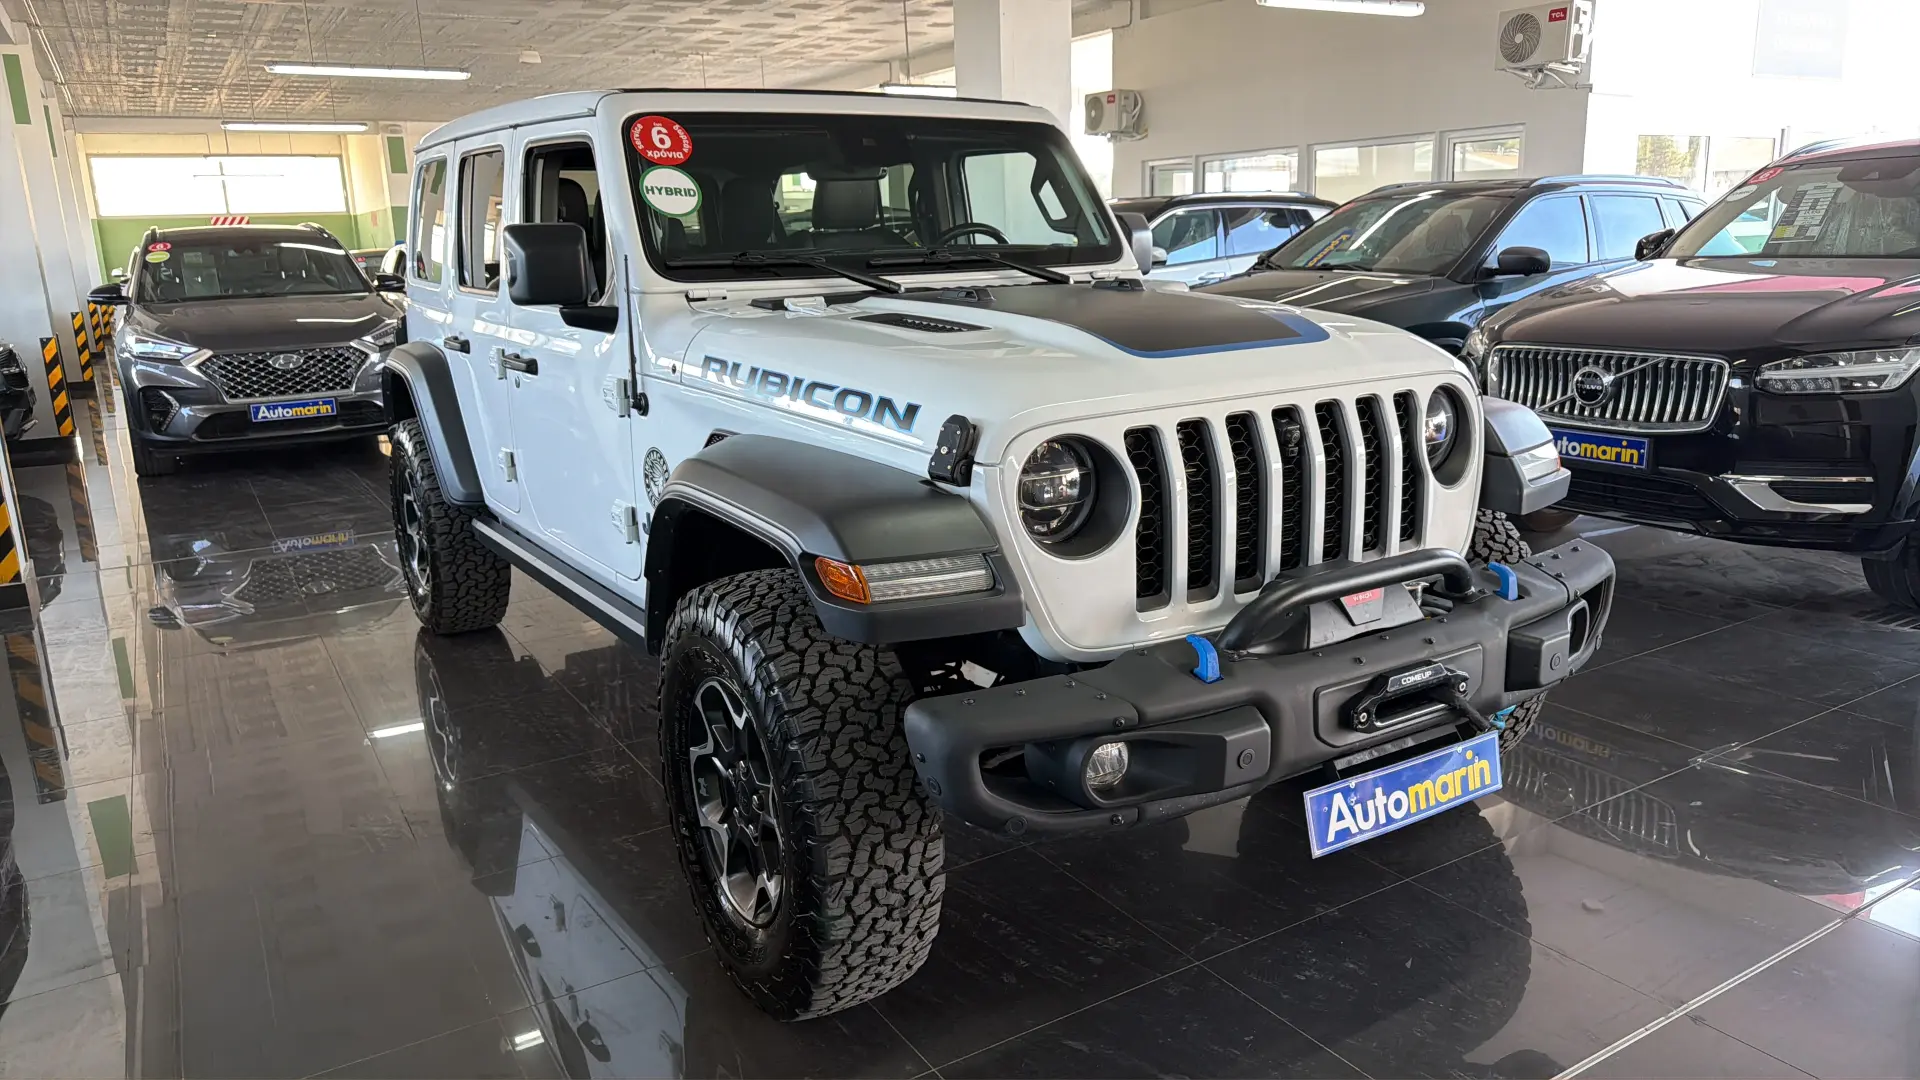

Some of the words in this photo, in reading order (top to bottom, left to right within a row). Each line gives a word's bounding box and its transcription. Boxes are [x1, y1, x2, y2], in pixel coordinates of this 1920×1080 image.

[1551, 11, 1564, 19] TCL
[633, 123, 644, 149] service
[651, 126, 672, 149] 6
[646, 149, 684, 159] χρόνια
[645, 186, 697, 197] HYBRID
[701, 355, 922, 433] RUBICON
[257, 401, 332, 419] Automarin
[1552, 436, 1639, 465] utomarin
[1401, 670, 1432, 686] COMEUP
[1326, 750, 1491, 843] Automarin
